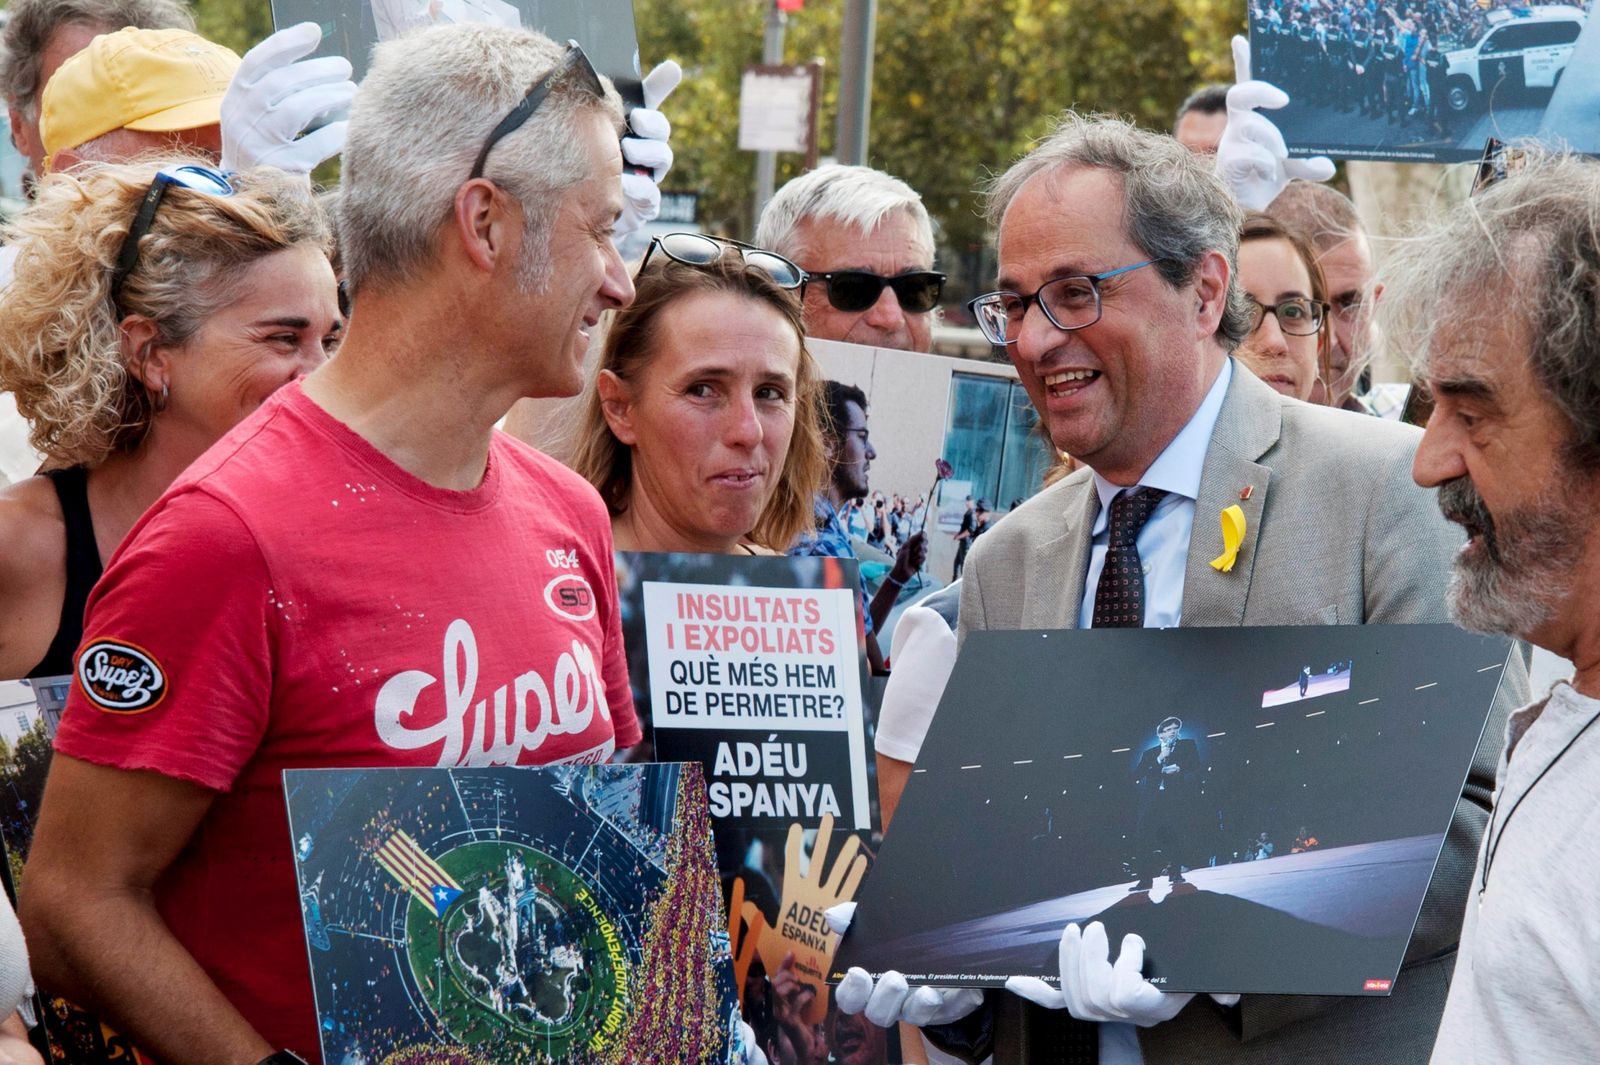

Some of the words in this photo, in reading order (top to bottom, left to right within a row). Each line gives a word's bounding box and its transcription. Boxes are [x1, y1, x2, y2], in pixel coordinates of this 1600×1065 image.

[545, 548, 580, 569] 054
[559, 587, 589, 606] SD
[676, 592, 821, 625] INSULTATS
[666, 623, 675, 649] I
[684, 624, 835, 655] EXPOLIATS
[86, 651, 151, 699] Super
[110, 655, 134, 669] DRY
[670, 654, 721, 686] QUÈ
[728, 656, 778, 688] MÉS
[785, 664, 836, 688] HEM
[374, 618, 611, 767] Super
[666, 691, 698, 715] DE
[705, 692, 844, 719] PERMETRE?
[713, 733, 808, 778] ADÉU
[708, 782, 842, 818] SPANYA
[575, 888, 628, 997] INDEPENDENCE
[782, 922, 826, 954] ESPANYA
[602, 997, 626, 1034] WANT
[588, 1030, 610, 1052] WE
